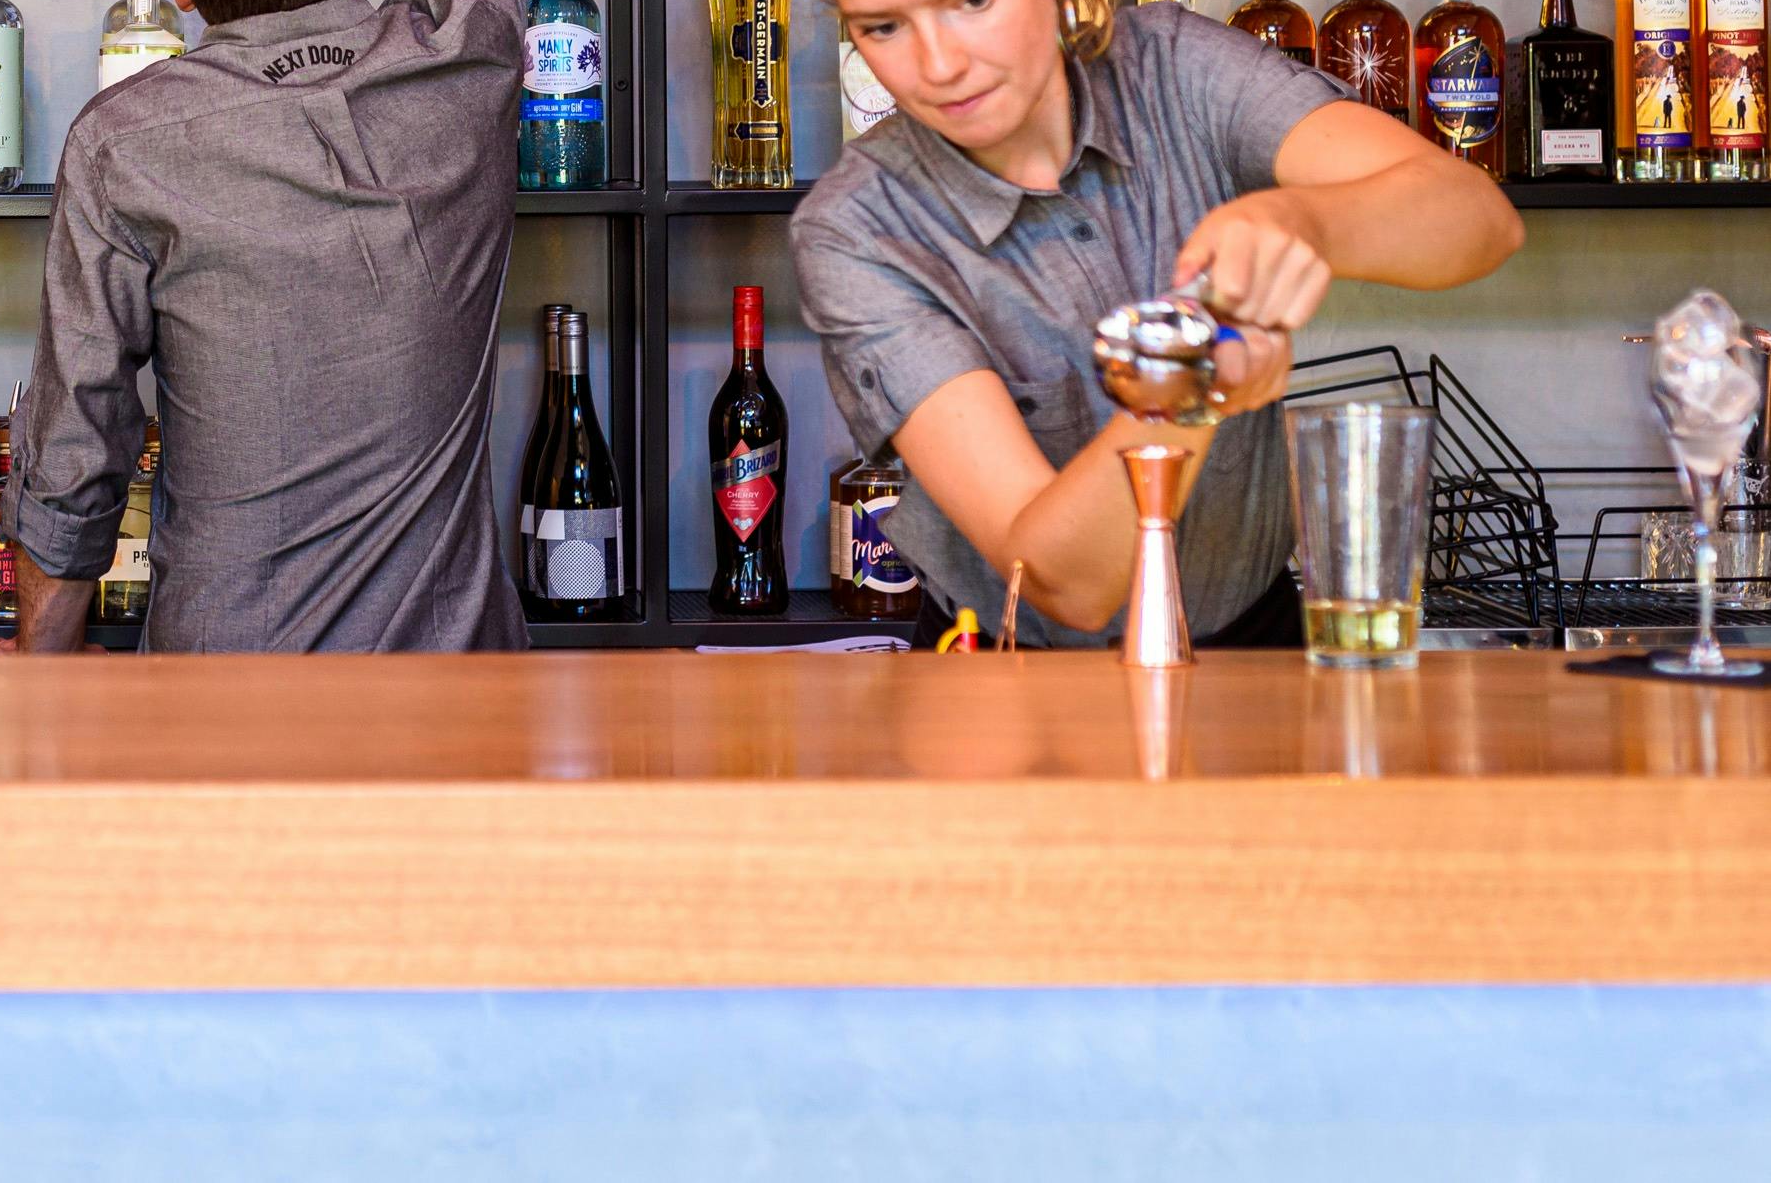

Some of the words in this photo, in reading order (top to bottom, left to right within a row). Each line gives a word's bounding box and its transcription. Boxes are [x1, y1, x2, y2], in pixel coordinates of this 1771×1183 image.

[538, 39, 572, 58] MANLY
[756, 1, 766, 79] ST-GERMAIN
[262, 49, 305, 84] NEXT
[308, 45, 355, 66] DOOR
[539, 56, 573, 72] SPIRITS
[534, 105, 558, 113] AUSTRALIAN
[571, 100, 584, 112] GIN
[736, 450, 777, 480] BRIZARD
[727, 490, 760, 499] CHERRY
